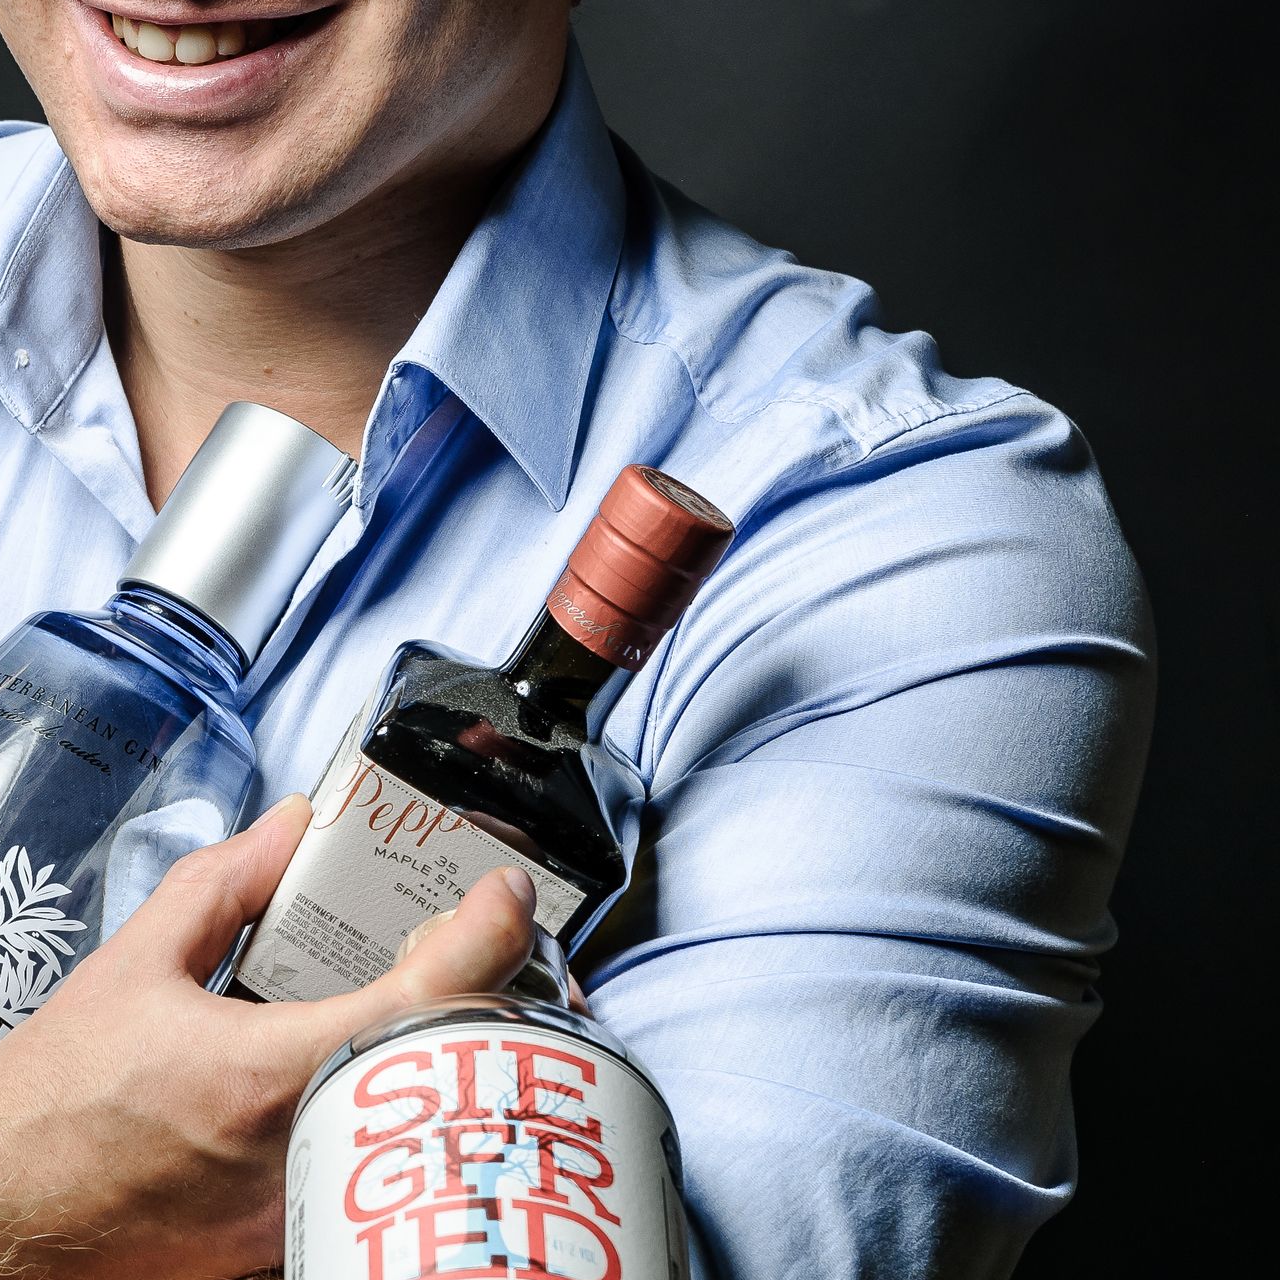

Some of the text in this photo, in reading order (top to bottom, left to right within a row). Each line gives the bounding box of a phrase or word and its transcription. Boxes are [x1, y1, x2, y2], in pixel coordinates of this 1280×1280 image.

[33, 725, 64, 740] de
[124, 739, 163, 774] GIN
[313, 752, 482, 848] Pepp
[373, 846, 466, 900] MAPLE STR
[434, 855, 461, 875] 35
[295, 892, 339, 924] GOVERNMENT
[338, 920, 370, 945] WARNING:
[393, 882, 441, 915] SPIRIT
[285, 909, 312, 931] BECAUSE
[320, 930, 332, 944] THE
[330, 939, 346, 953] RISK
[353, 953, 372, 969] BIRTH
[290, 900, 313, 920] WOMEN
[311, 915, 335, 934] SHOULD
[333, 929, 347, 941] NOT
[345, 937, 364, 952] DRINK
[296, 928, 330, 954] BEVERAGES
[327, 949, 353, 969] IMPAIRS
[351, 963, 369, 978] YOUR
[307, 948, 321, 960] AND
[320, 955, 334, 968] MAY
[332, 963, 353, 981] CAUSE
[353, 1039, 603, 1148] SIE
[343, 1124, 622, 1227] GFR
